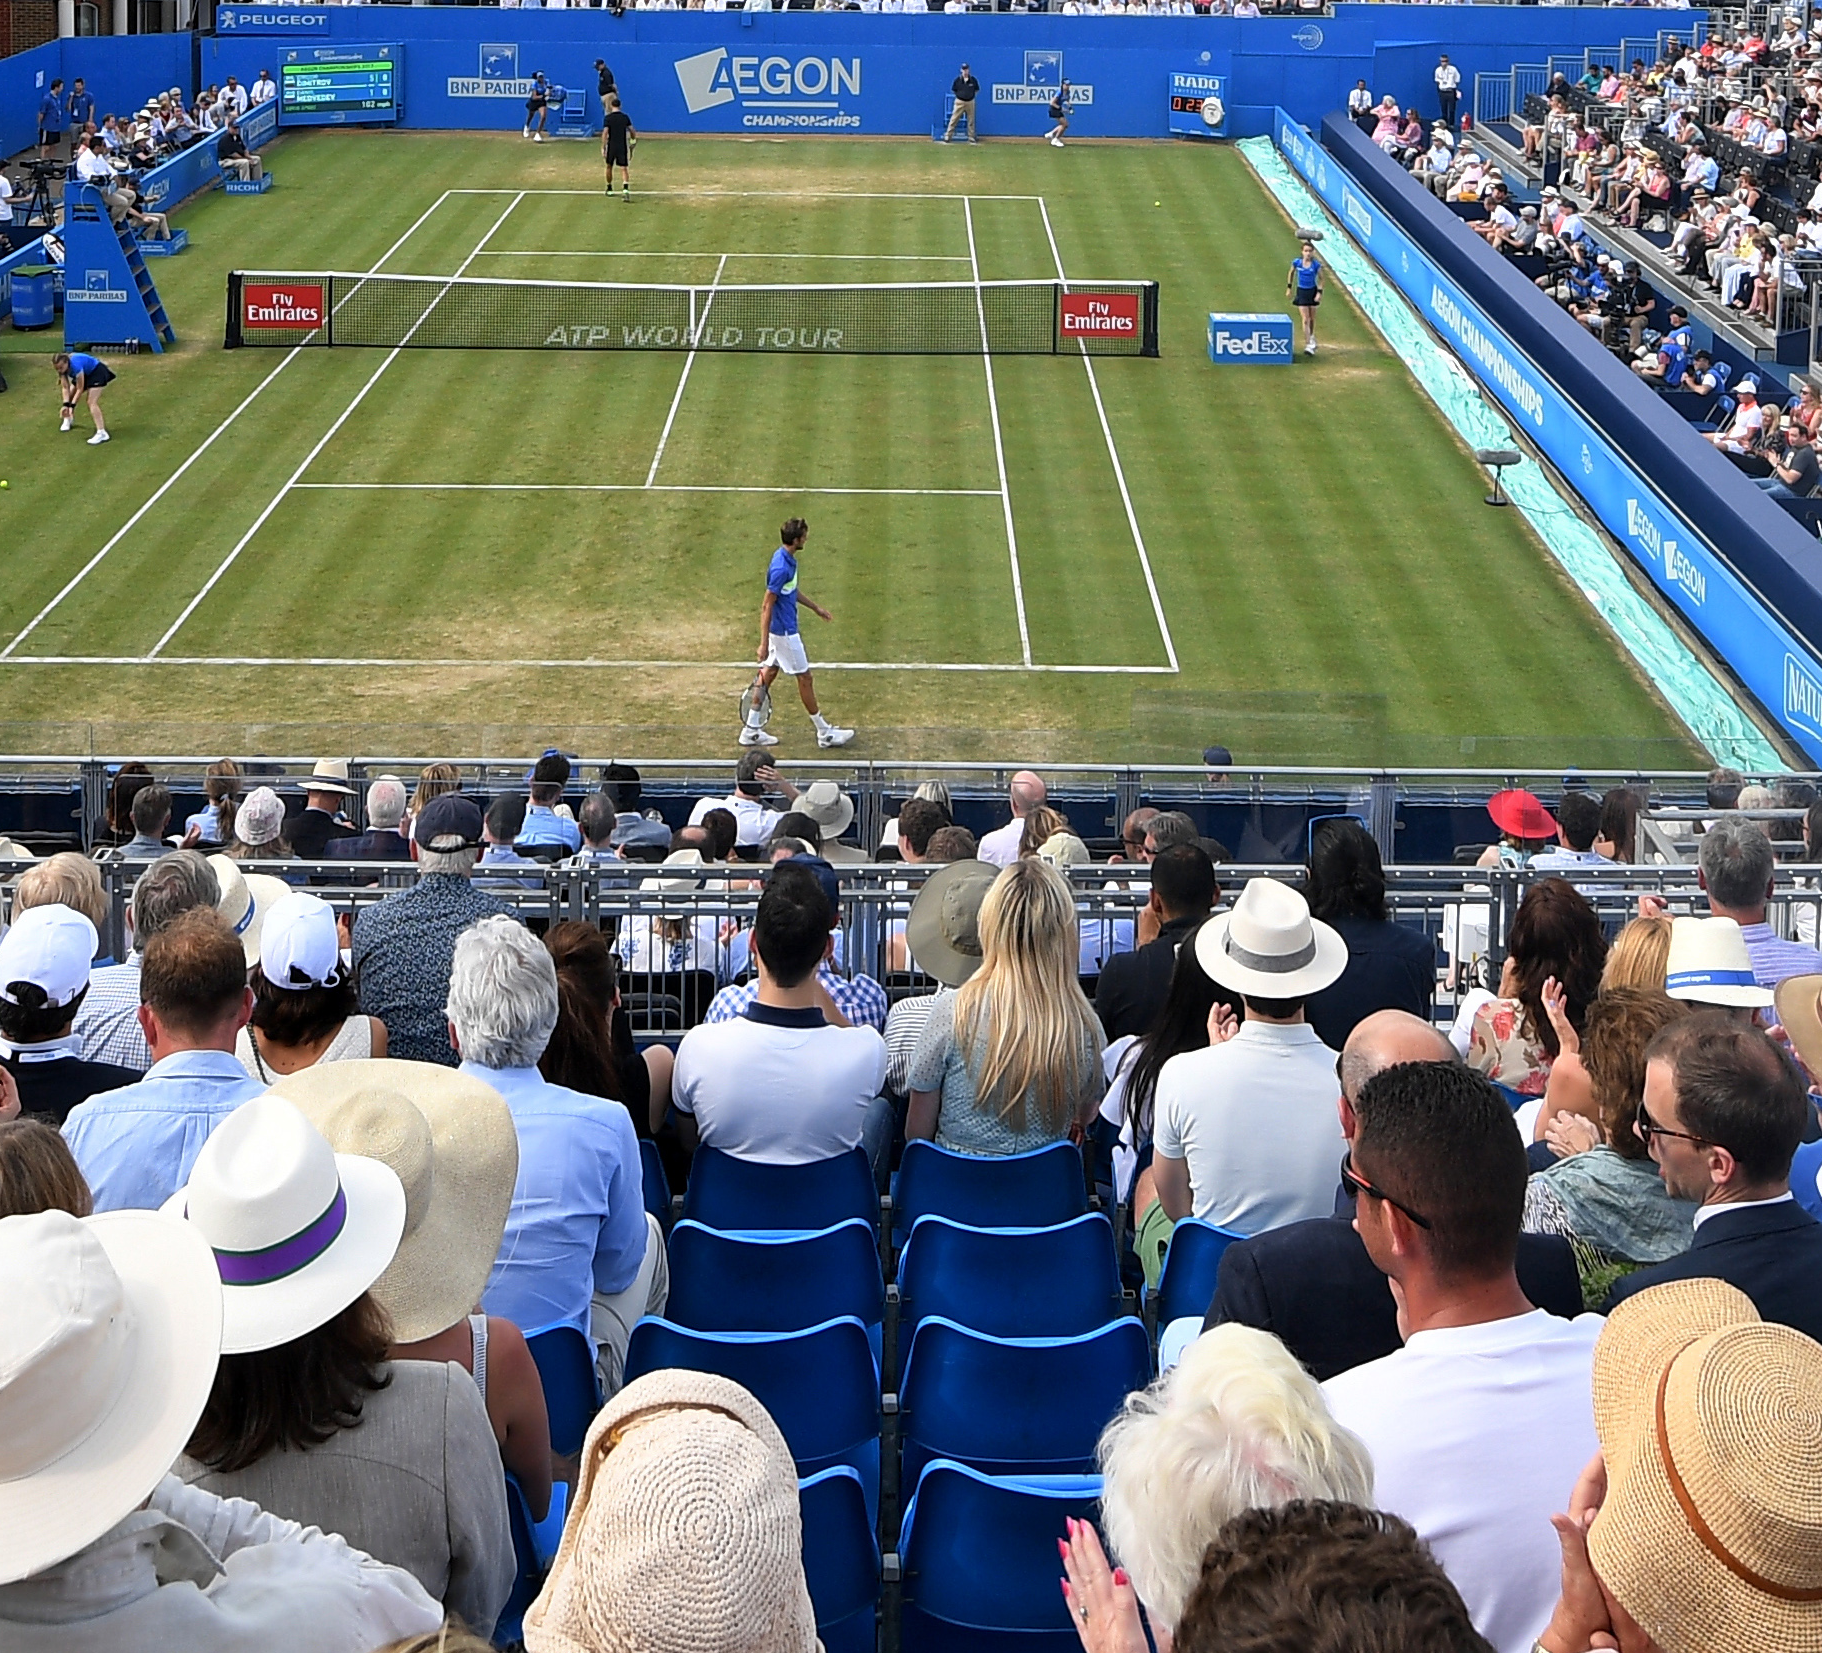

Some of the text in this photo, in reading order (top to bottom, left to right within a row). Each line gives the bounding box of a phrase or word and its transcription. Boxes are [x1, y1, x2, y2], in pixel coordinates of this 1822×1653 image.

[239, 14, 327, 26] PEUGEOT
[707, 56, 861, 95] AEGON
[1174, 75, 1220, 90] RADO
[450, 82, 533, 95] BNP PARIB
[995, 88, 1090, 102] BNP PARAS
[742, 111, 861, 127] CHAMPIONSHIPS
[226, 184, 259, 192] RICOH
[68, 292, 125, 301] BNP PARIBAS
[272, 293, 293, 307] Fly
[247, 304, 318, 321] Emirates
[1088, 301, 1109, 316] Fly
[1064, 313, 1133, 331] Emirates
[544, 325, 845, 348] ATP WORLD TOUR
[1216, 331, 1290, 355] FedEx
[1431, 284, 1544, 427] AEGON CHAMPIONSHIPS
[1632, 506, 1661, 558] AEGON
[1671, 549, 1706, 604] AEGON
